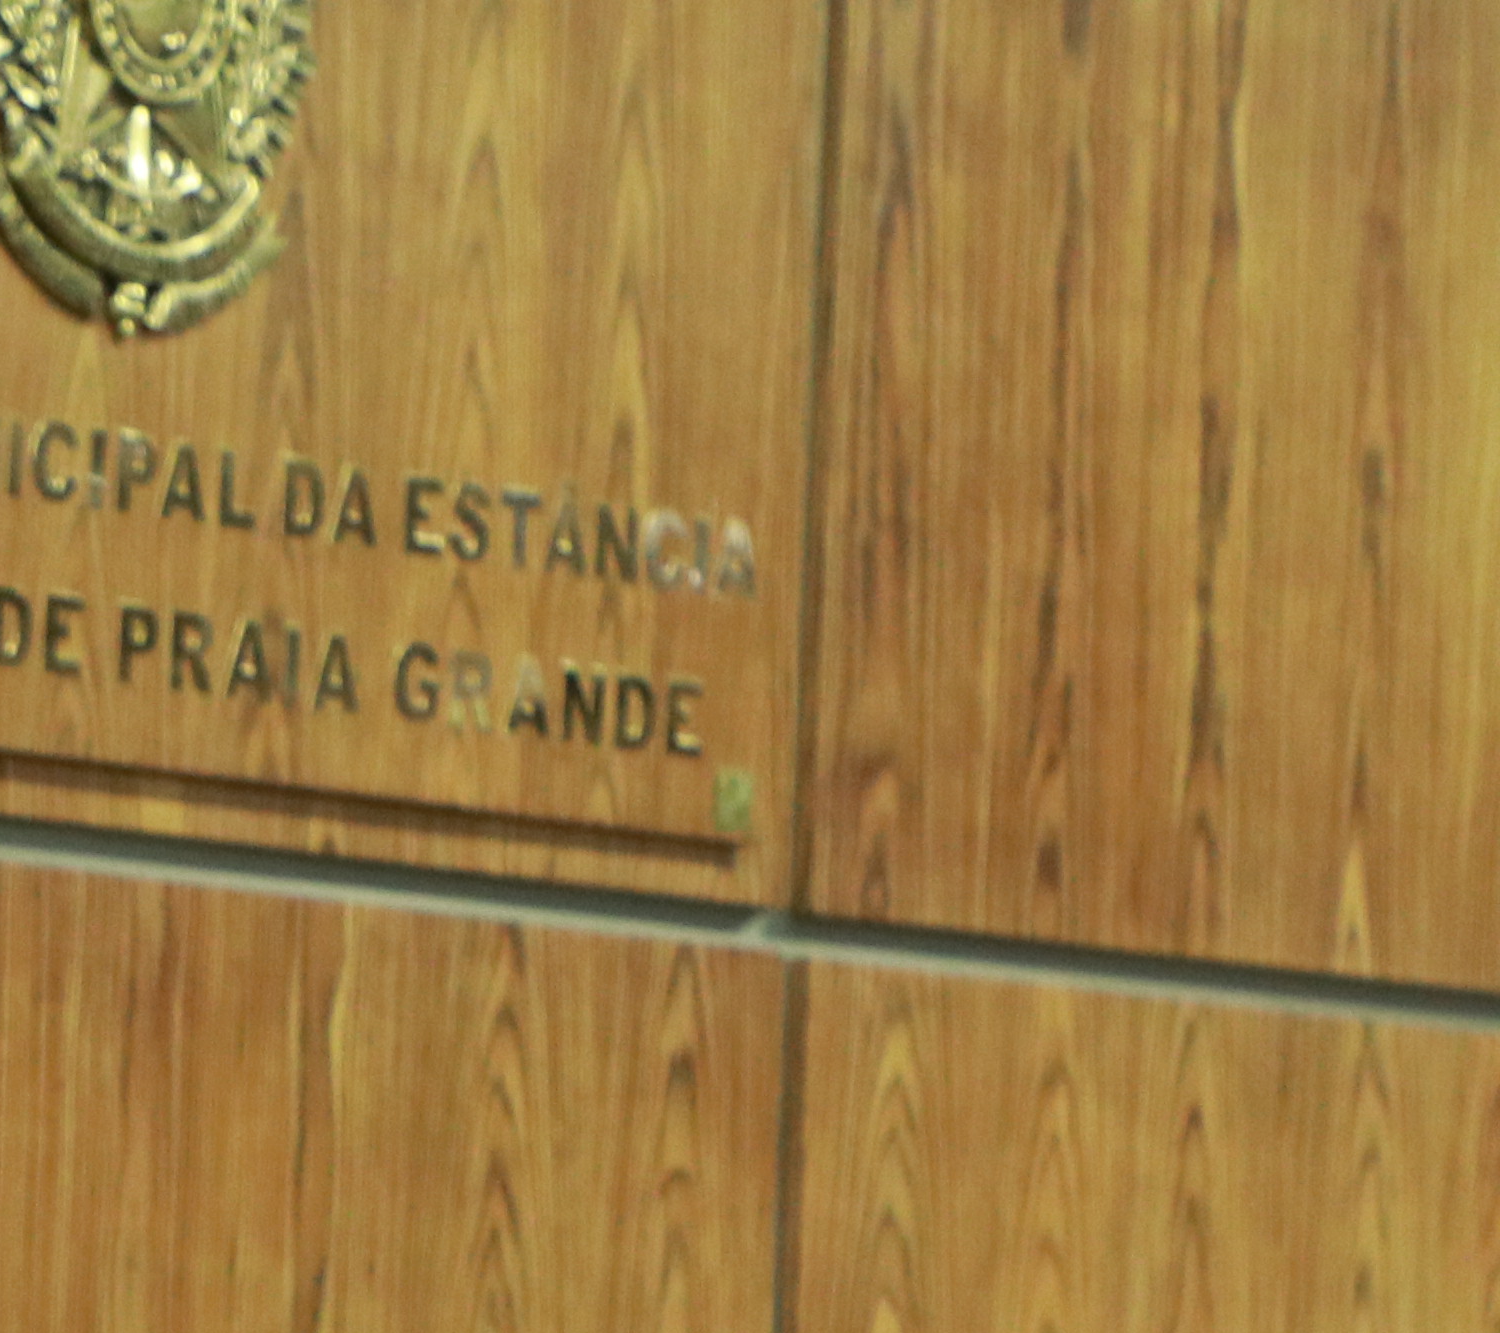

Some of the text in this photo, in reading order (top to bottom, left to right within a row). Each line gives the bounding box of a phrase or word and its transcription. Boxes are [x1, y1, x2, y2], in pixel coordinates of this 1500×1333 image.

[284, 450, 379, 548] DA
[404, 474, 757, 598] ESTÂNCIA
[117, 600, 359, 713] PRAIA
[394, 638, 703, 758] GRANDE
